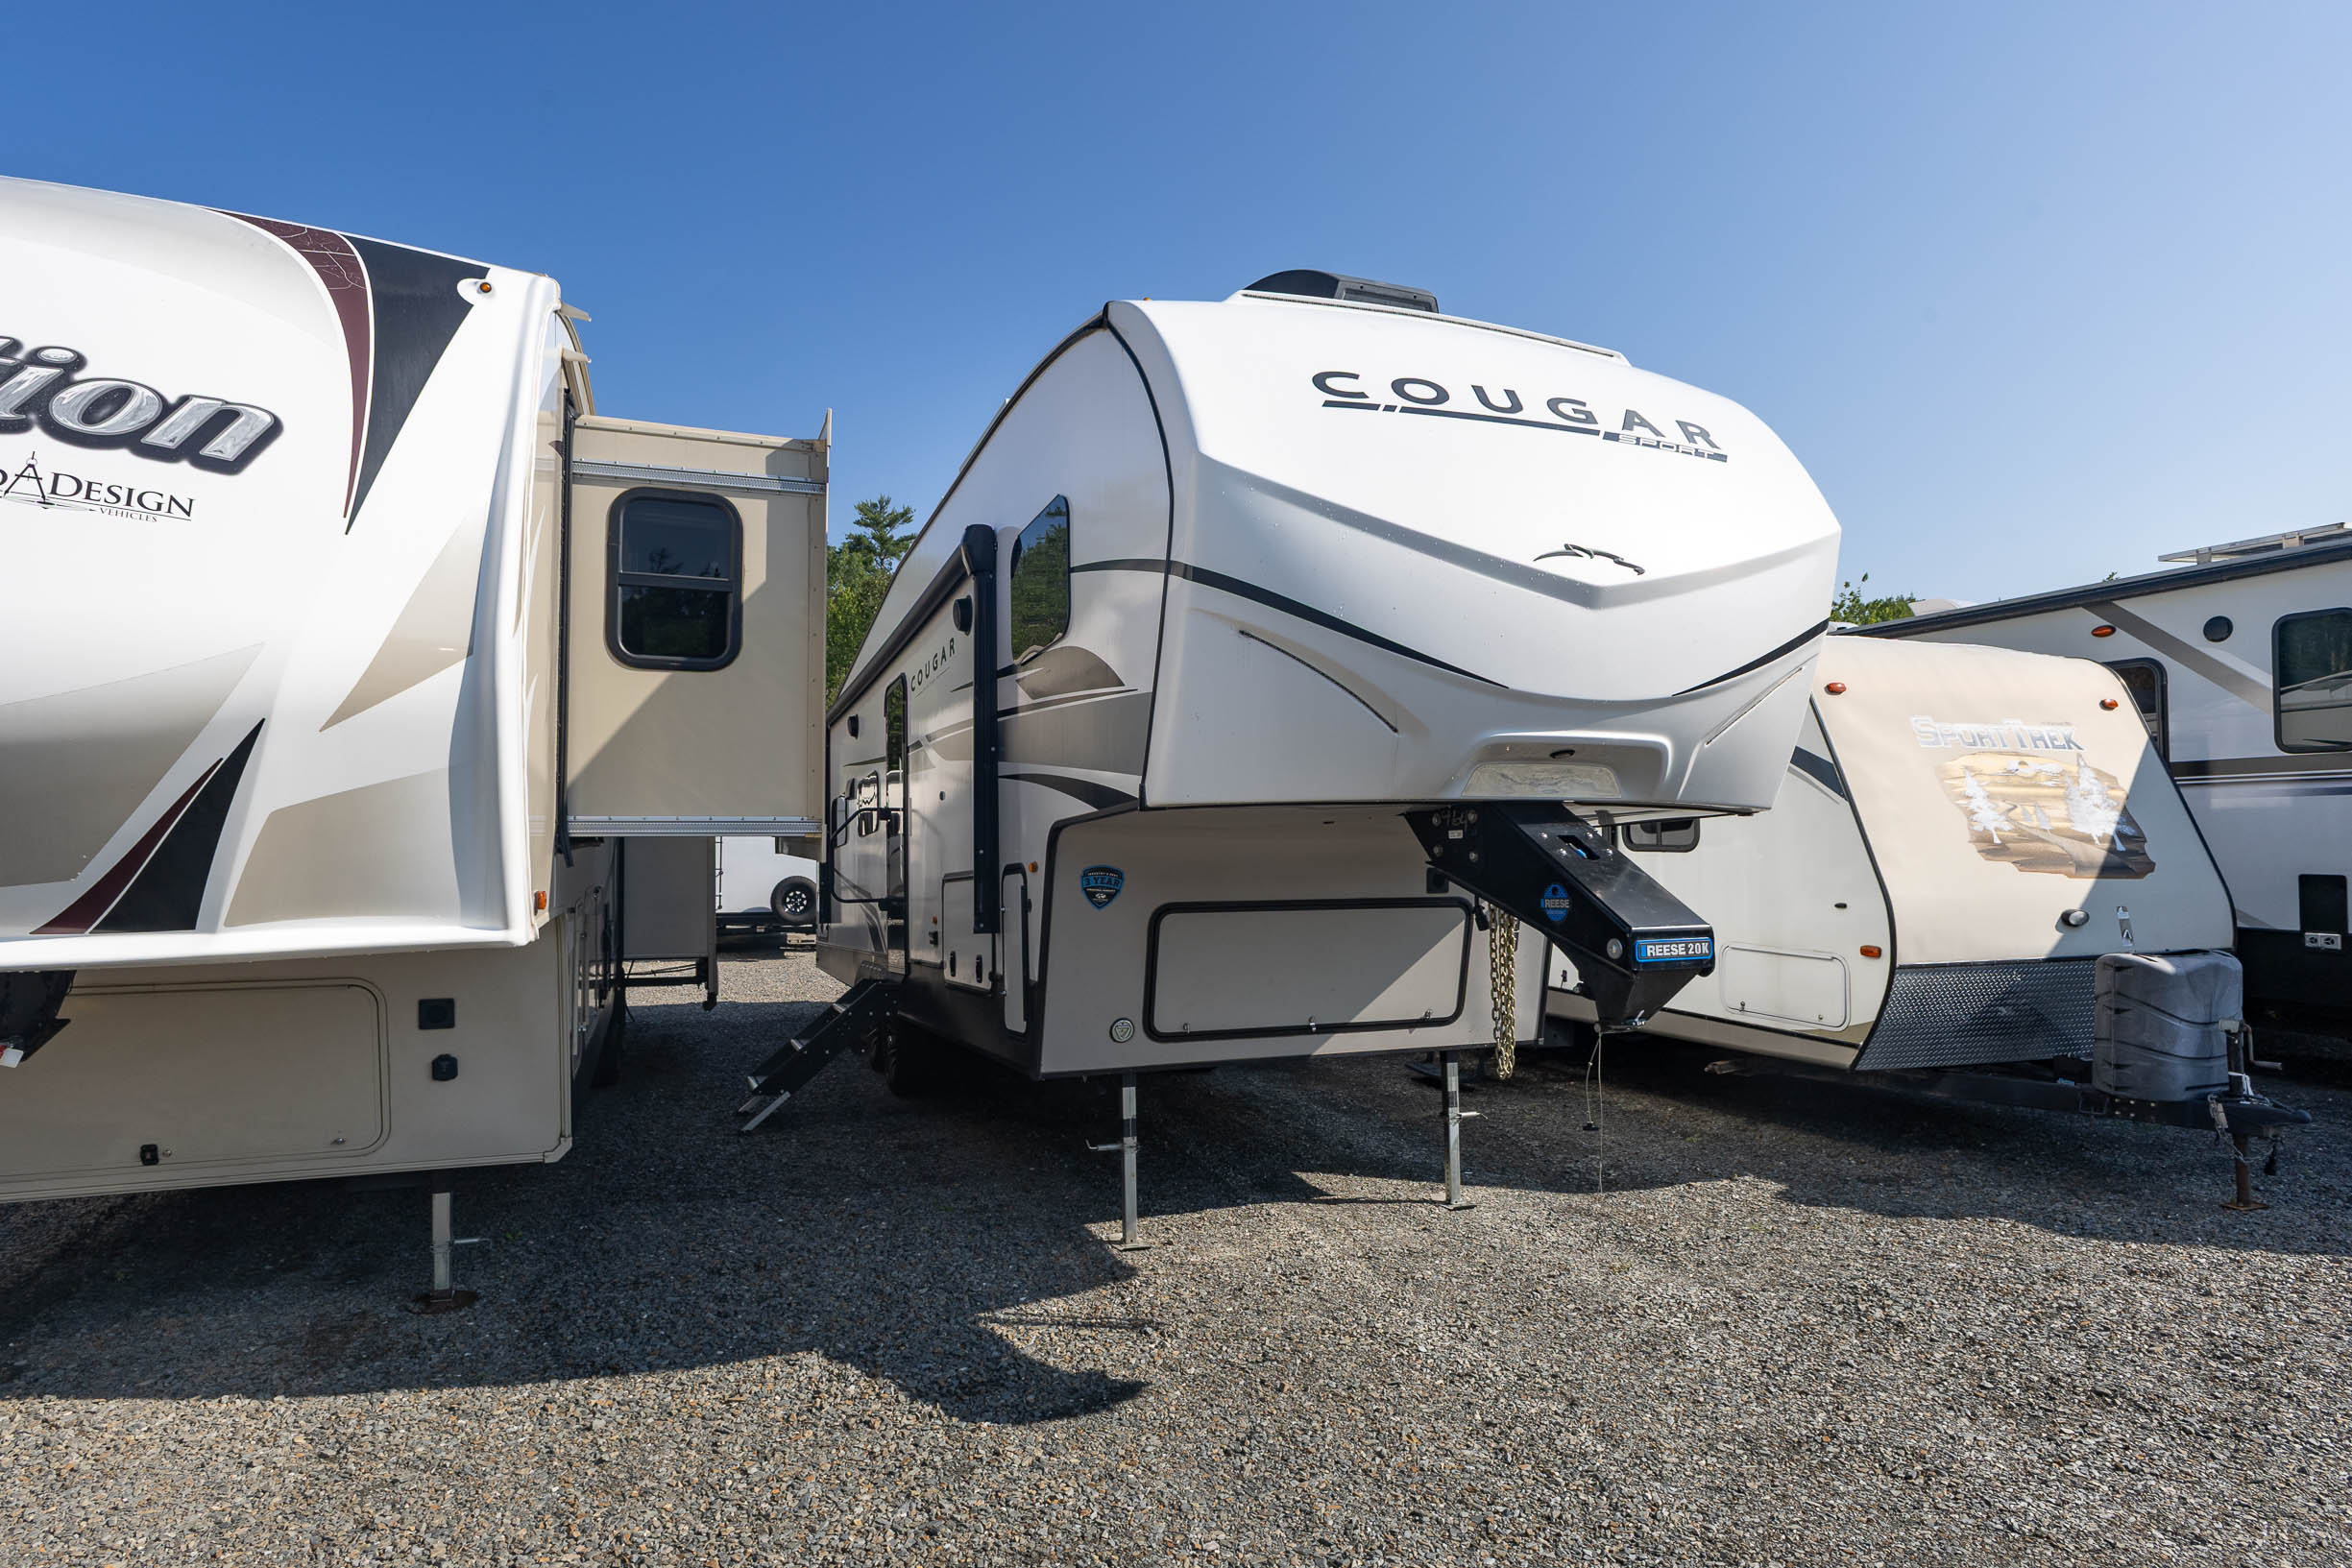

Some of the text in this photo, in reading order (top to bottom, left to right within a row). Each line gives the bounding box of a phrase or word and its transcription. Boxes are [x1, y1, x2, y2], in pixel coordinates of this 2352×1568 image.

[1312, 371, 1722, 449] COUGAR
[1617, 433, 1713, 459] SPORT
[50, 471, 195, 518] DESIGN
[100, 506, 158, 523] VEHICLES
[910, 638, 955, 691] COUGAR
[1544, 899, 1570, 908] REESE
[1646, 942, 1709, 956] REESE 20K
